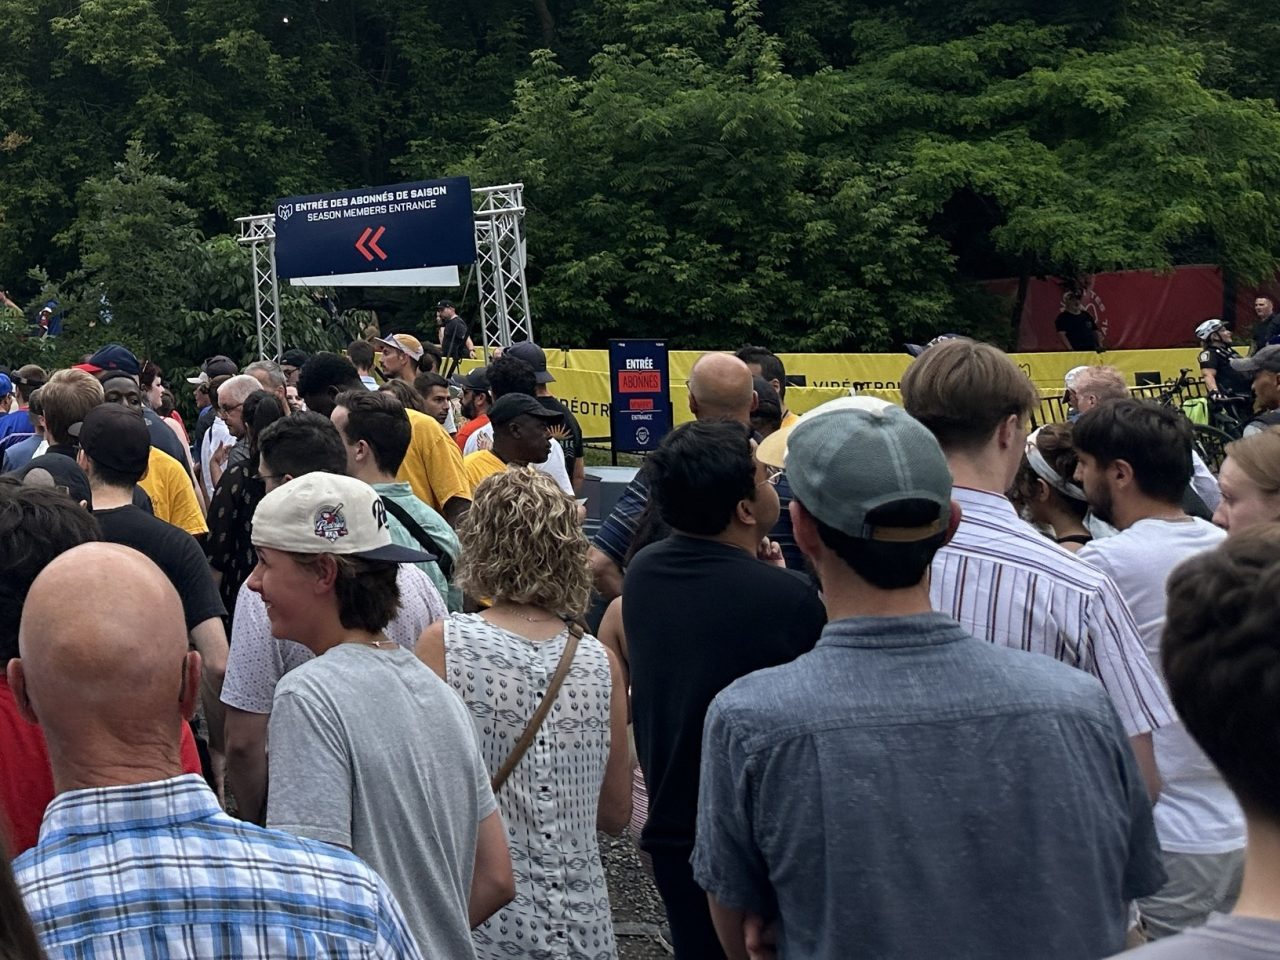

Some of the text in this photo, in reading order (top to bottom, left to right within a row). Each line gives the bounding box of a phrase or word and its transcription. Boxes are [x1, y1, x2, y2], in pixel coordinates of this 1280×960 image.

[295, 186, 447, 212] ENTRÉE DES ABONNÉS DE SAISON
[307, 199, 437, 222] SEASON MEMBERS ENTRANCE
[626, 357, 654, 370] ENTRÉE
